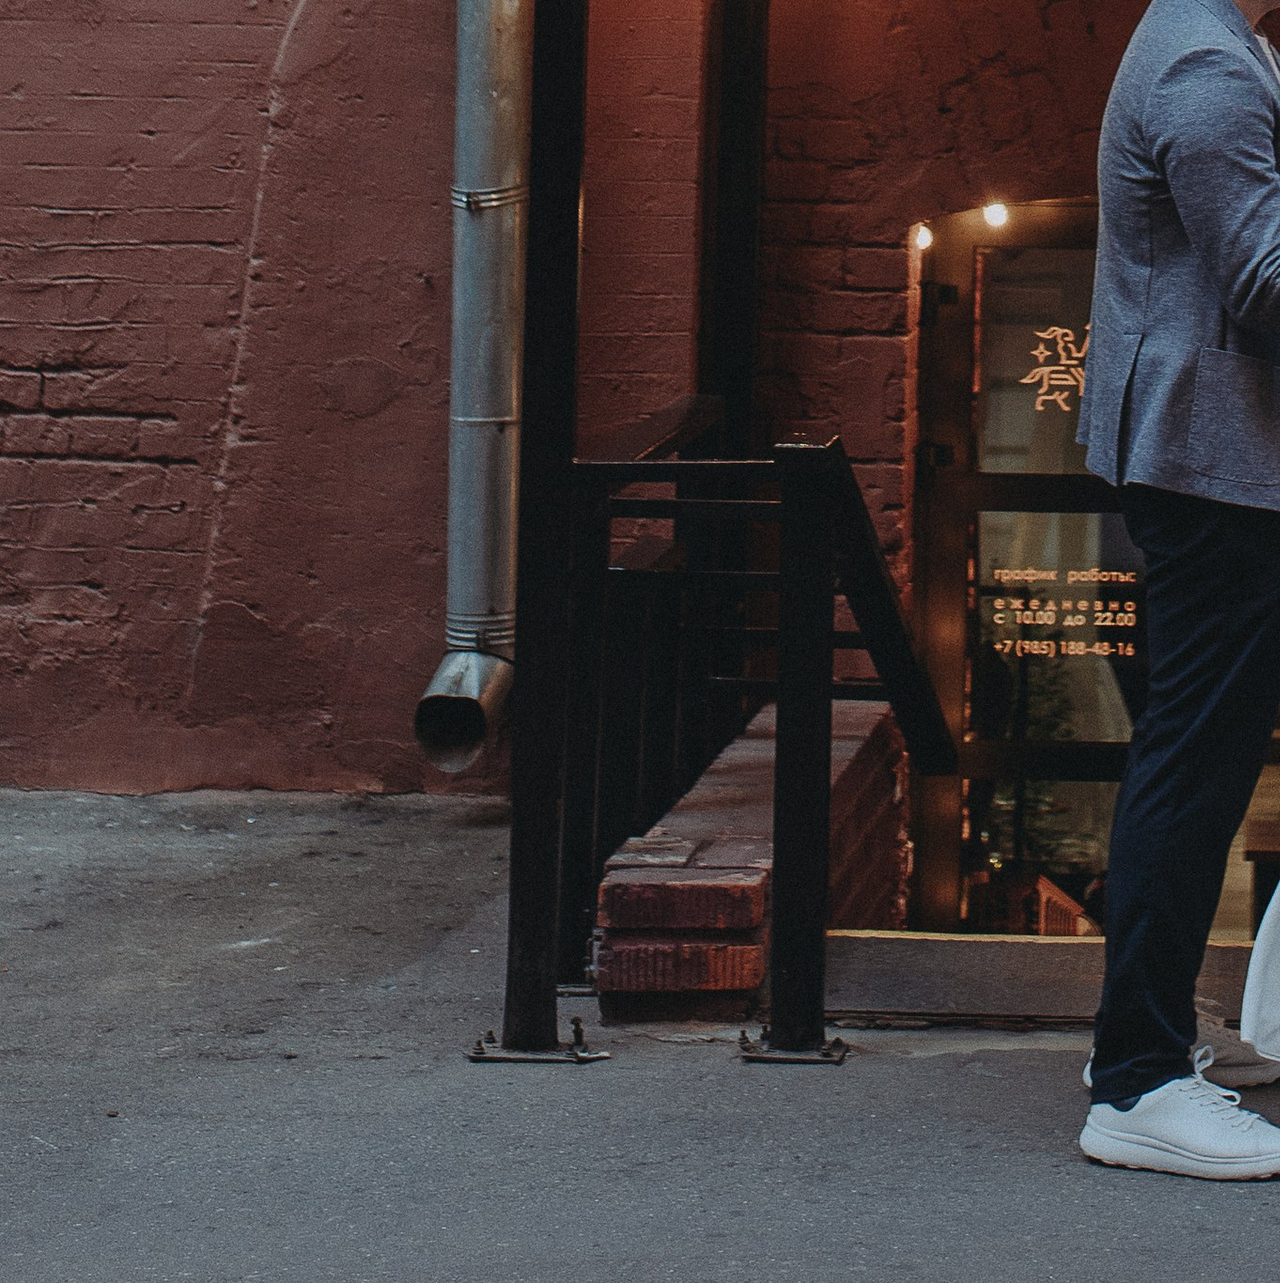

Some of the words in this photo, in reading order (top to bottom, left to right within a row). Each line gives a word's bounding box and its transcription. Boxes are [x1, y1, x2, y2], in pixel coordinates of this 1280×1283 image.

[994, 568, 1058, 583] график
[993, 598, 1136, 611] ежедневно
[1015, 611, 1056, 625] 10.00
[1062, 614, 1087, 626] до
[1093, 612, 1137, 626] 22.00
[993, 640, 1013, 654] +7
